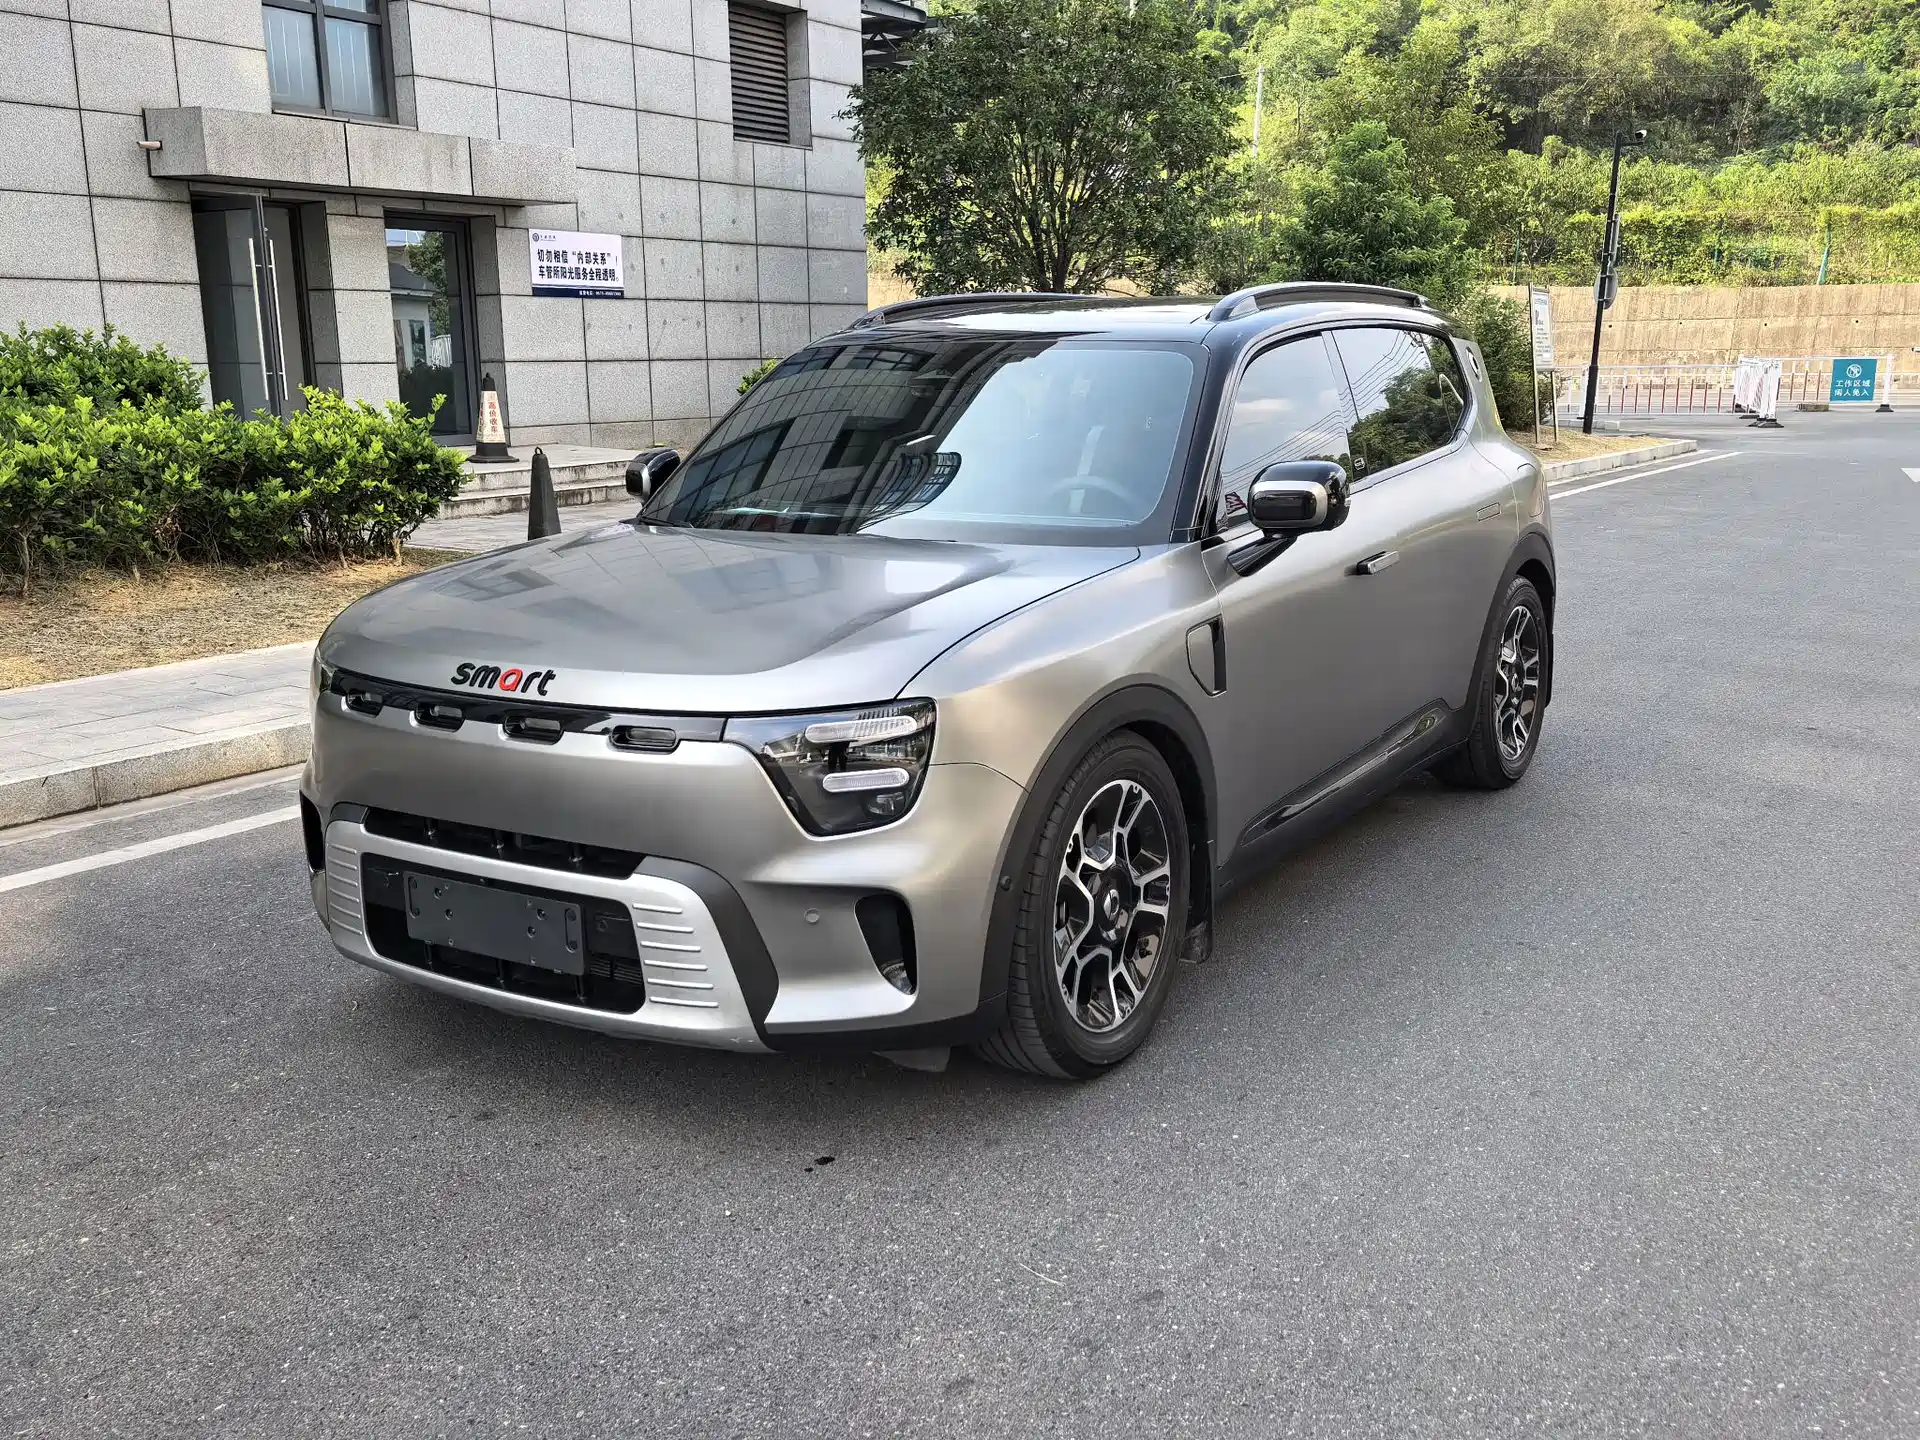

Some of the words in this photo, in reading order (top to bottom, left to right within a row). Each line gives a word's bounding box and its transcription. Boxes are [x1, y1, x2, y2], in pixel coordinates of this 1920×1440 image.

[1835, 379, 1871, 388] 工作区域
[1834, 388, 1869, 397] 闲人免入
[450, 662, 556, 696] smart
